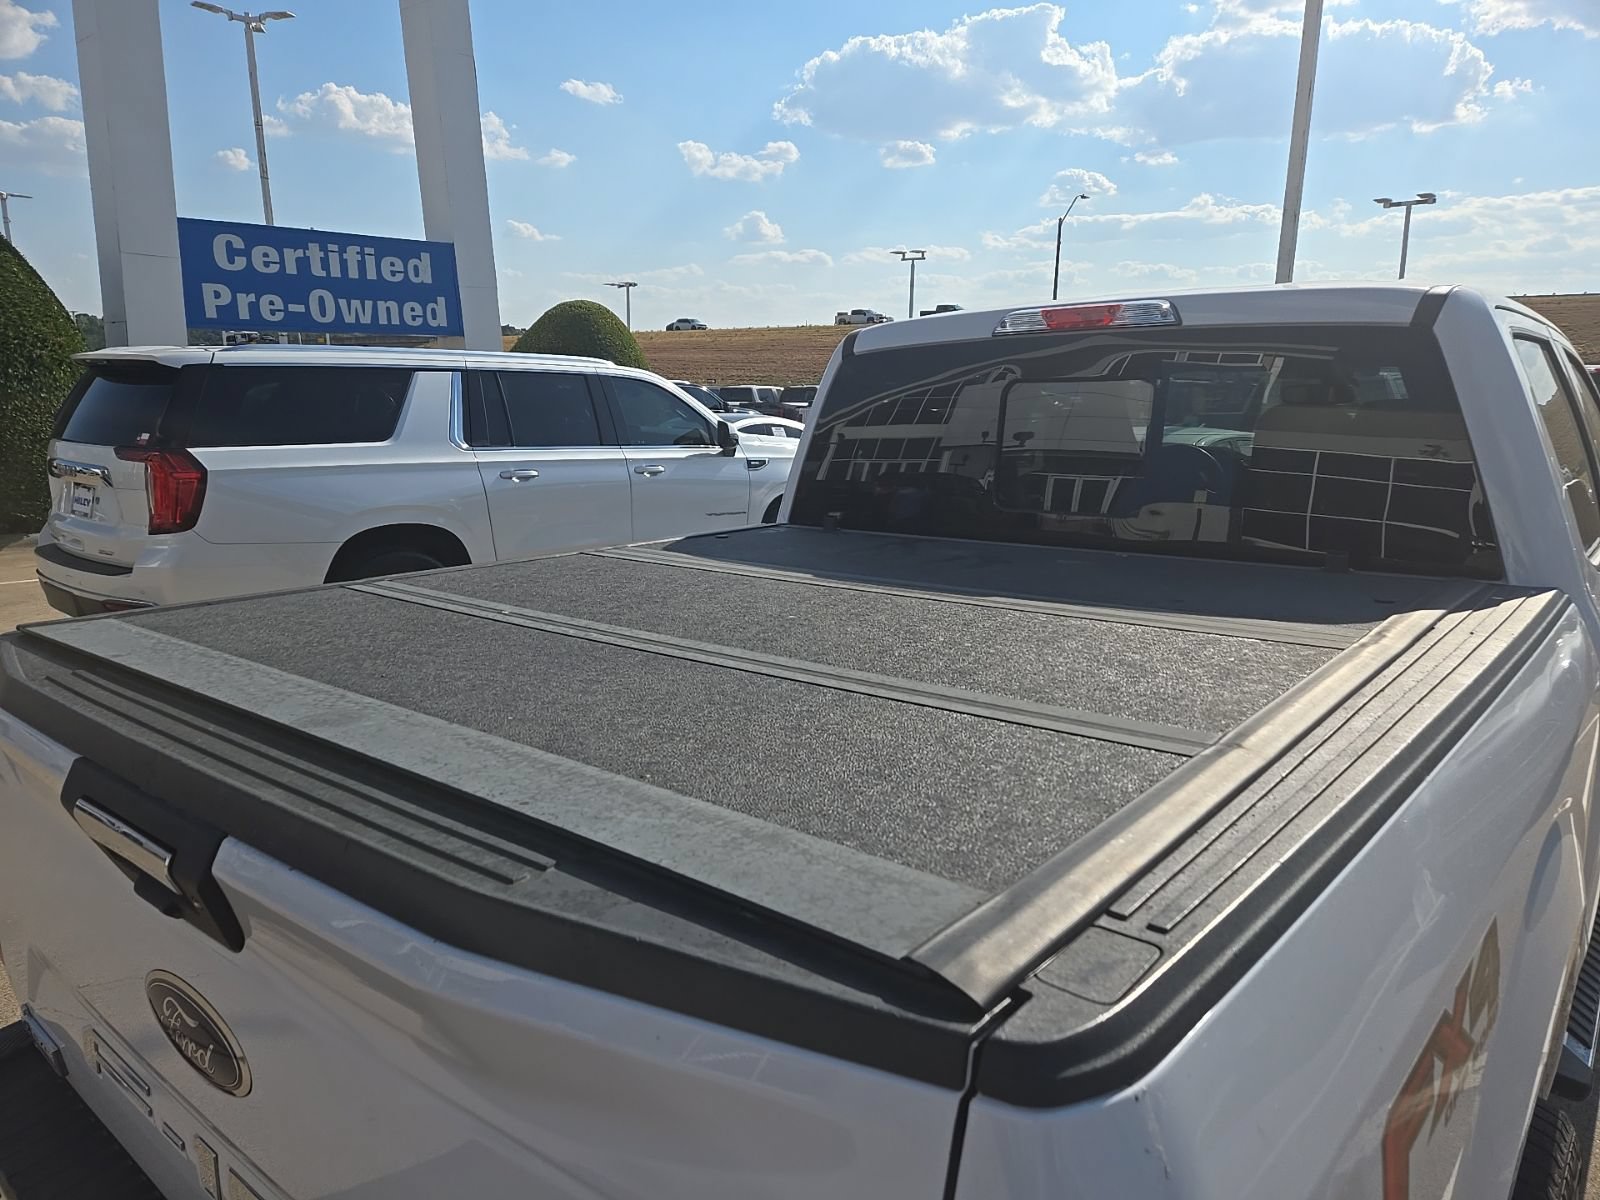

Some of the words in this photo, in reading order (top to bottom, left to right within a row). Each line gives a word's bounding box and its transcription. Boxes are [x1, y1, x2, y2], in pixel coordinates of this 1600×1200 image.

[212, 234, 432, 284] Certified
[201, 283, 447, 327] Pre-Owned
[161, 996, 216, 1075] Ford
